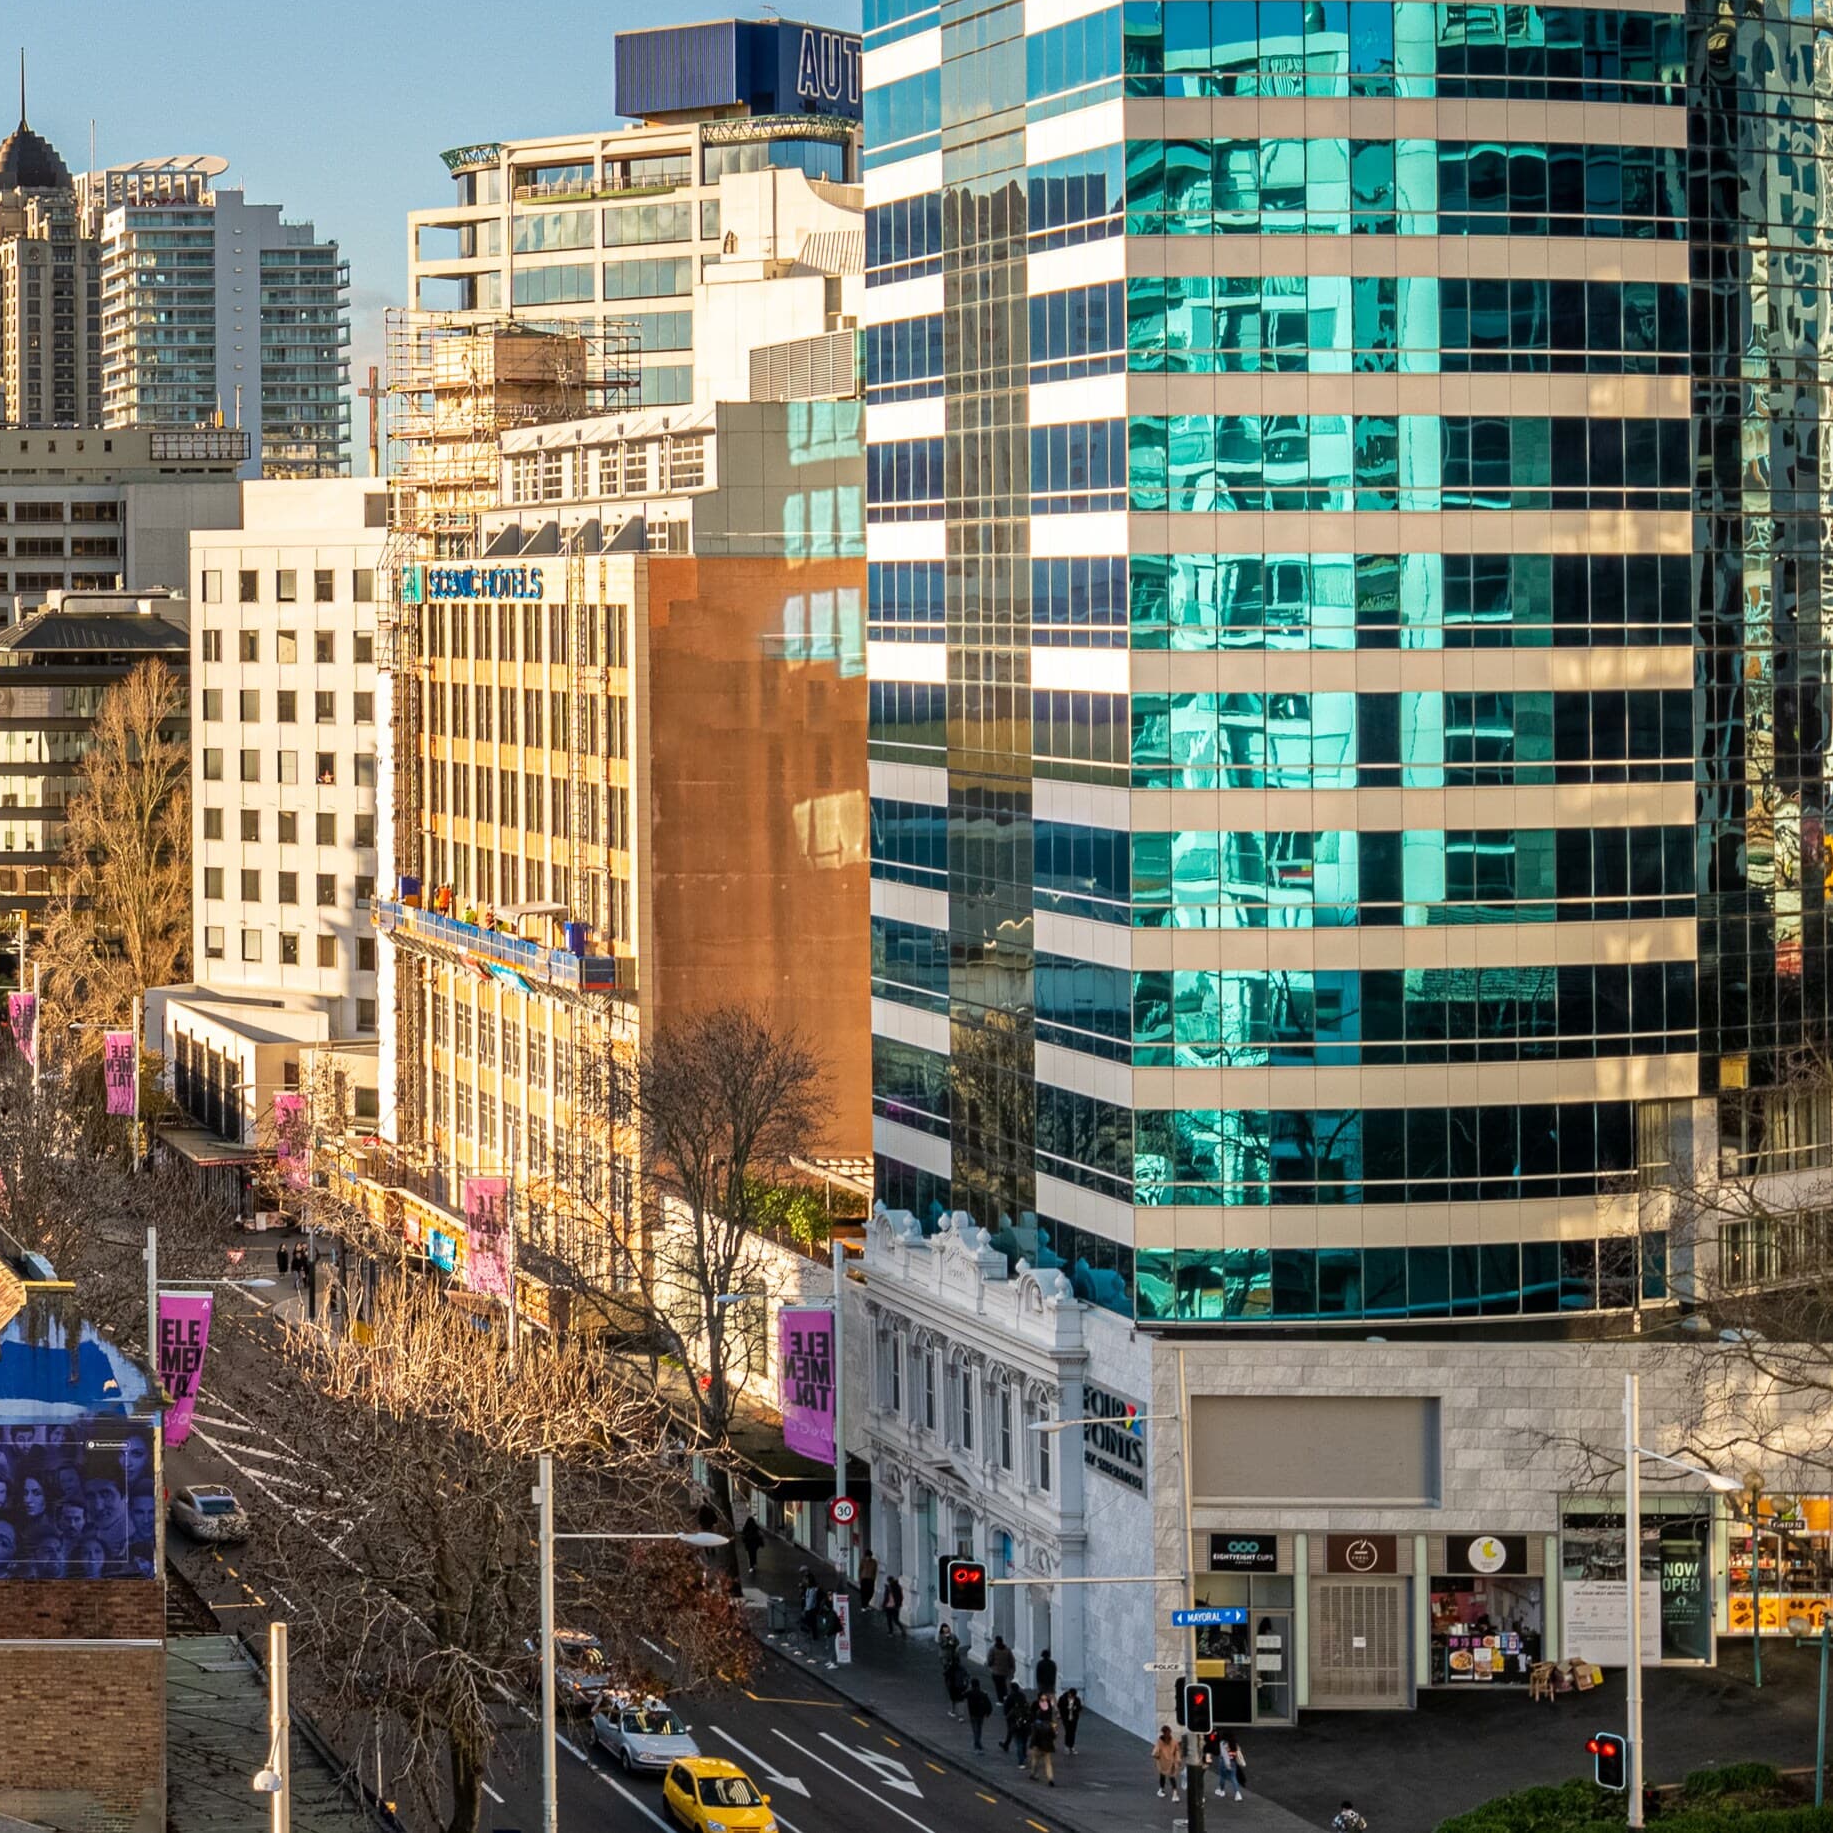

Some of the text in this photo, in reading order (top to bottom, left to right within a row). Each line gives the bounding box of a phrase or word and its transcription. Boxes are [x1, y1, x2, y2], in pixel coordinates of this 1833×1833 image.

[429, 567, 544, 599] SCENIC HOTELS
[161, 1318, 201, 1347] ELE
[836, 1505, 852, 1517] 30
[1256, 1554, 1274, 1562] CUPS
[1663, 1562, 1700, 1577] NOW
[1662, 1577, 1701, 1593] OPEN
[1187, 1612, 1222, 1623] MAYORAL
